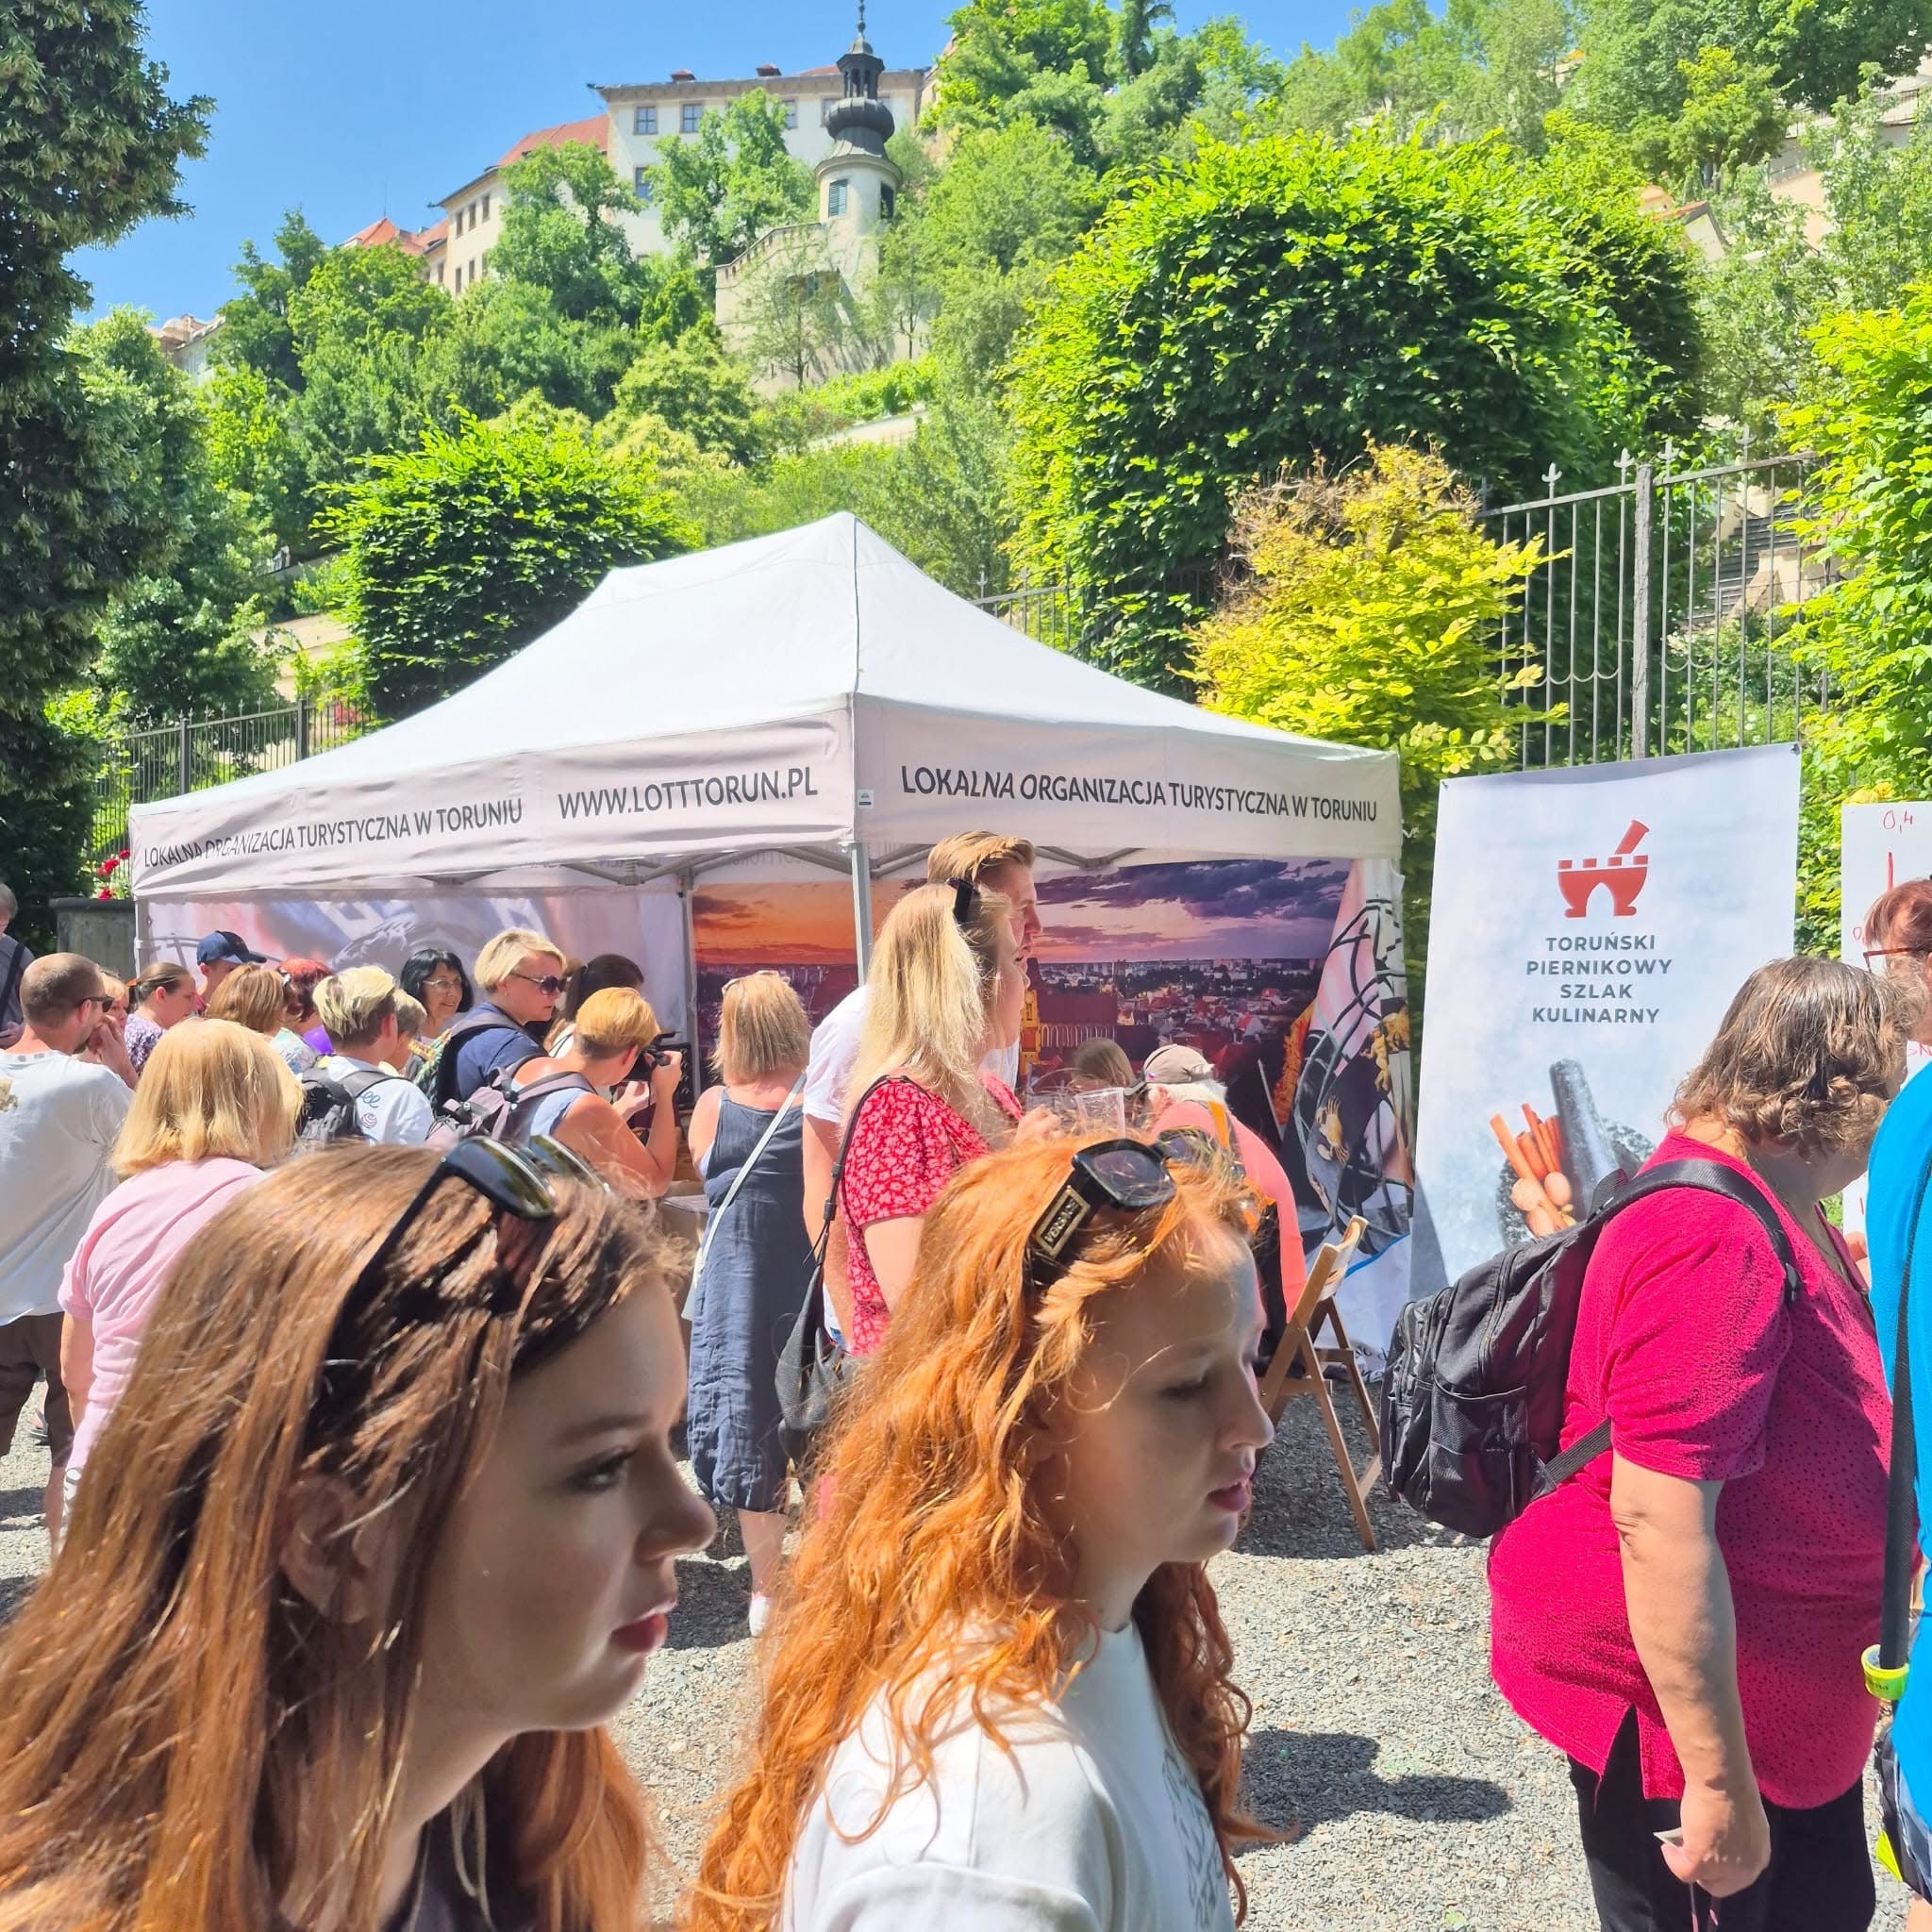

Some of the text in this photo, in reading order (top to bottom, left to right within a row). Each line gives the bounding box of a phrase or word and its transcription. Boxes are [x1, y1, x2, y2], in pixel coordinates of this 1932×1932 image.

[558, 766, 818, 819] WWW.LOTTTORUN.PL
[902, 765, 1377, 823] LOKALNA ORGANIZACJA TURYSTYCZNA W TORUNIU
[144, 798, 522, 868] LOKALNA ORGANIZACJA TURYSTYCZNA W TORUNIU
[1546, 931, 1655, 951] TORUŃSKI
[1526, 958, 1673, 975] PIERNIKOWY
[1560, 984, 1633, 1000] SZLAK
[1532, 1008, 1659, 1024] KULINARNY
